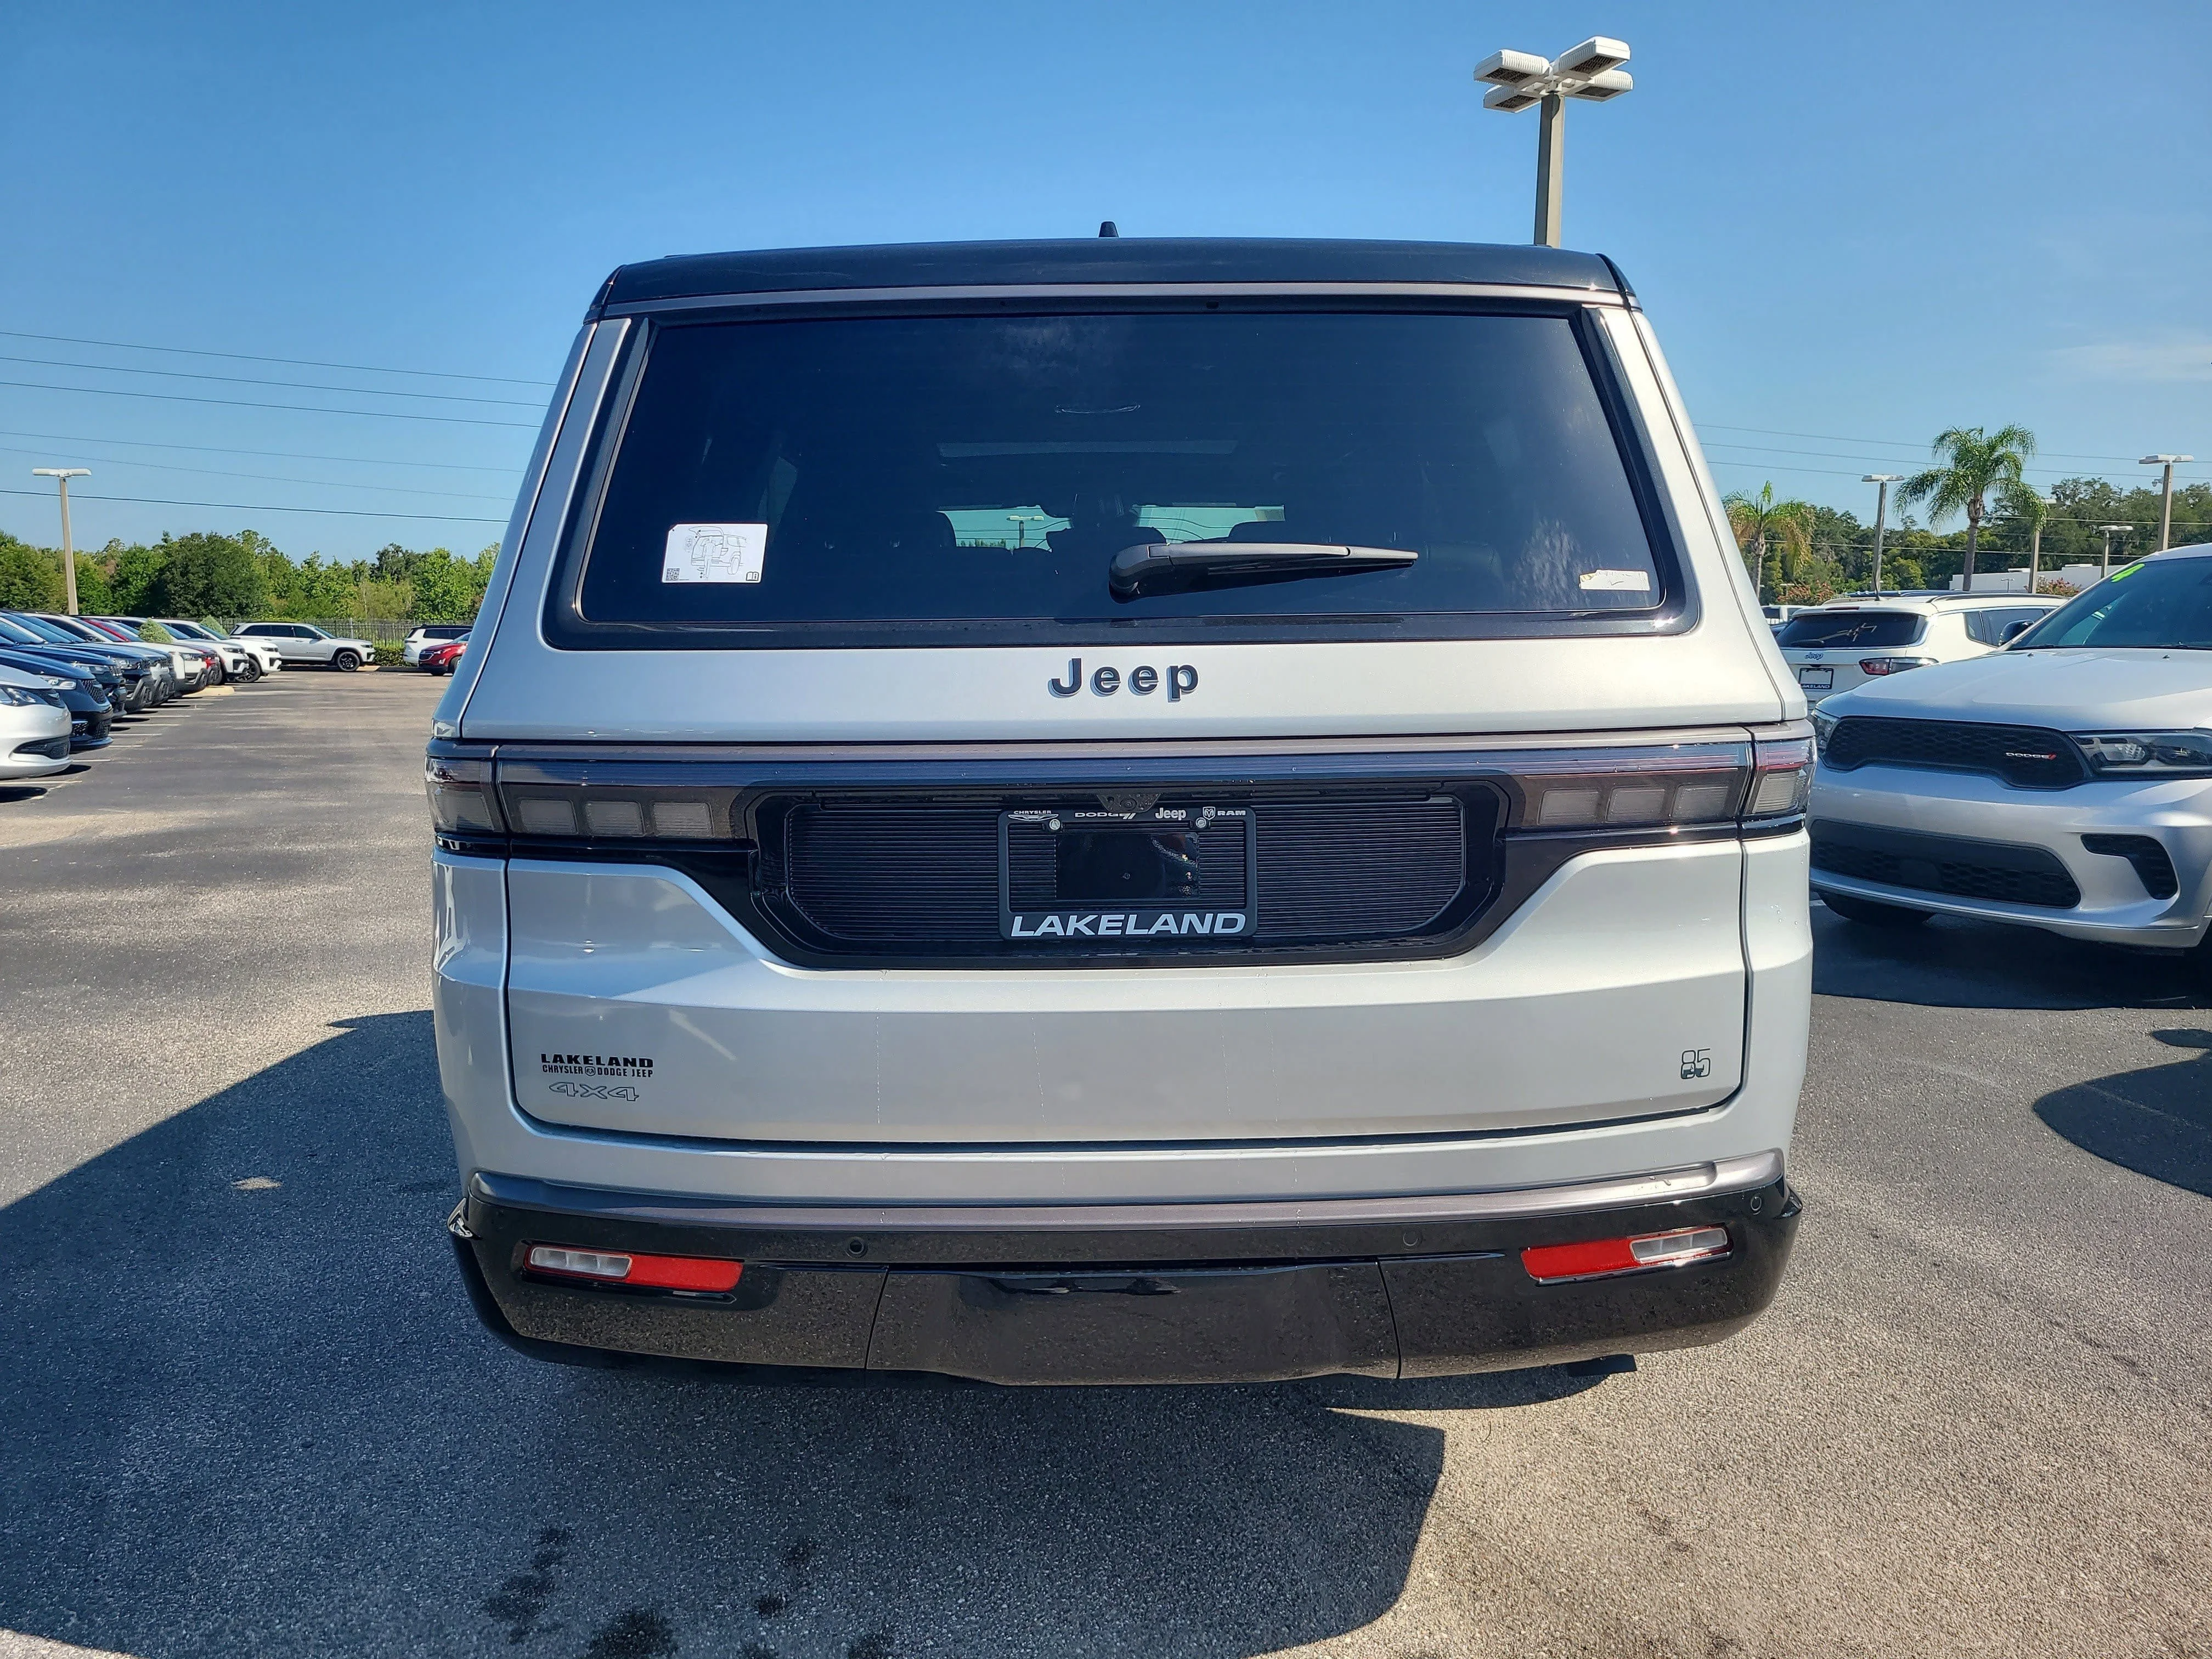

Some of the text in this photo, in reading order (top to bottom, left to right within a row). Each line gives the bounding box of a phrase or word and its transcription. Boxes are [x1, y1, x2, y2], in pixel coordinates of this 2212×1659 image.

[1048, 658, 1199, 702] Jeep
[1155, 808, 1186, 820] Jeep
[1011, 913, 1246, 937] LAKELAND
[541, 1053, 654, 1068] LAKELAND
[542, 1065, 653, 1077] CHRYSLER DODGE JEEP
